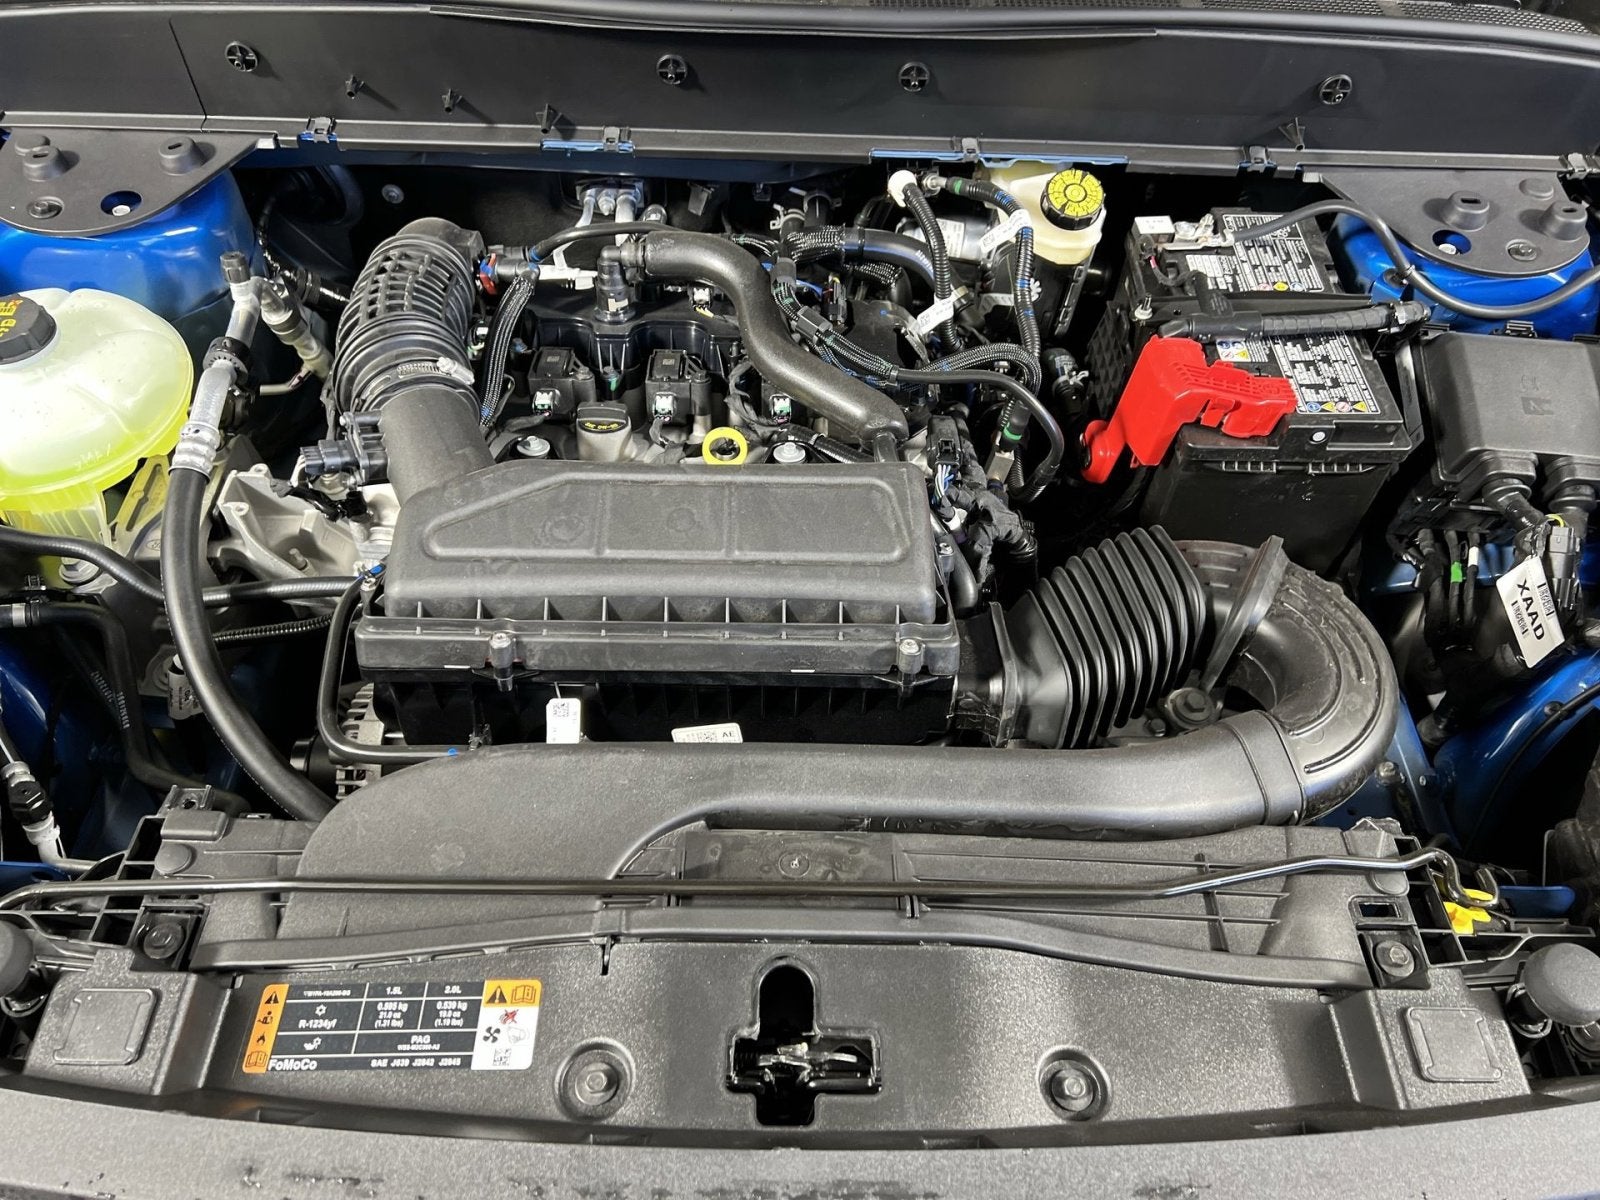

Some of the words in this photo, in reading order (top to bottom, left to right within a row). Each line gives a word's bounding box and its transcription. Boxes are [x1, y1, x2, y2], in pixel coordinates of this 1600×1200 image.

[1517, 579, 1545, 641] XAAD
[386, 986, 403, 995] 1.5L
[444, 985, 461, 994] 2.0L
[398, 1002, 409, 1012] kg
[436, 1001, 456, 1010] 0.539
[457, 1001, 468, 1011] kg
[298, 1018, 337, 1029] R-1234yf
[411, 1035, 431, 1044] PAG
[268, 1058, 318, 1071] FoMoCo
[370, 1059, 388, 1068] SAE
